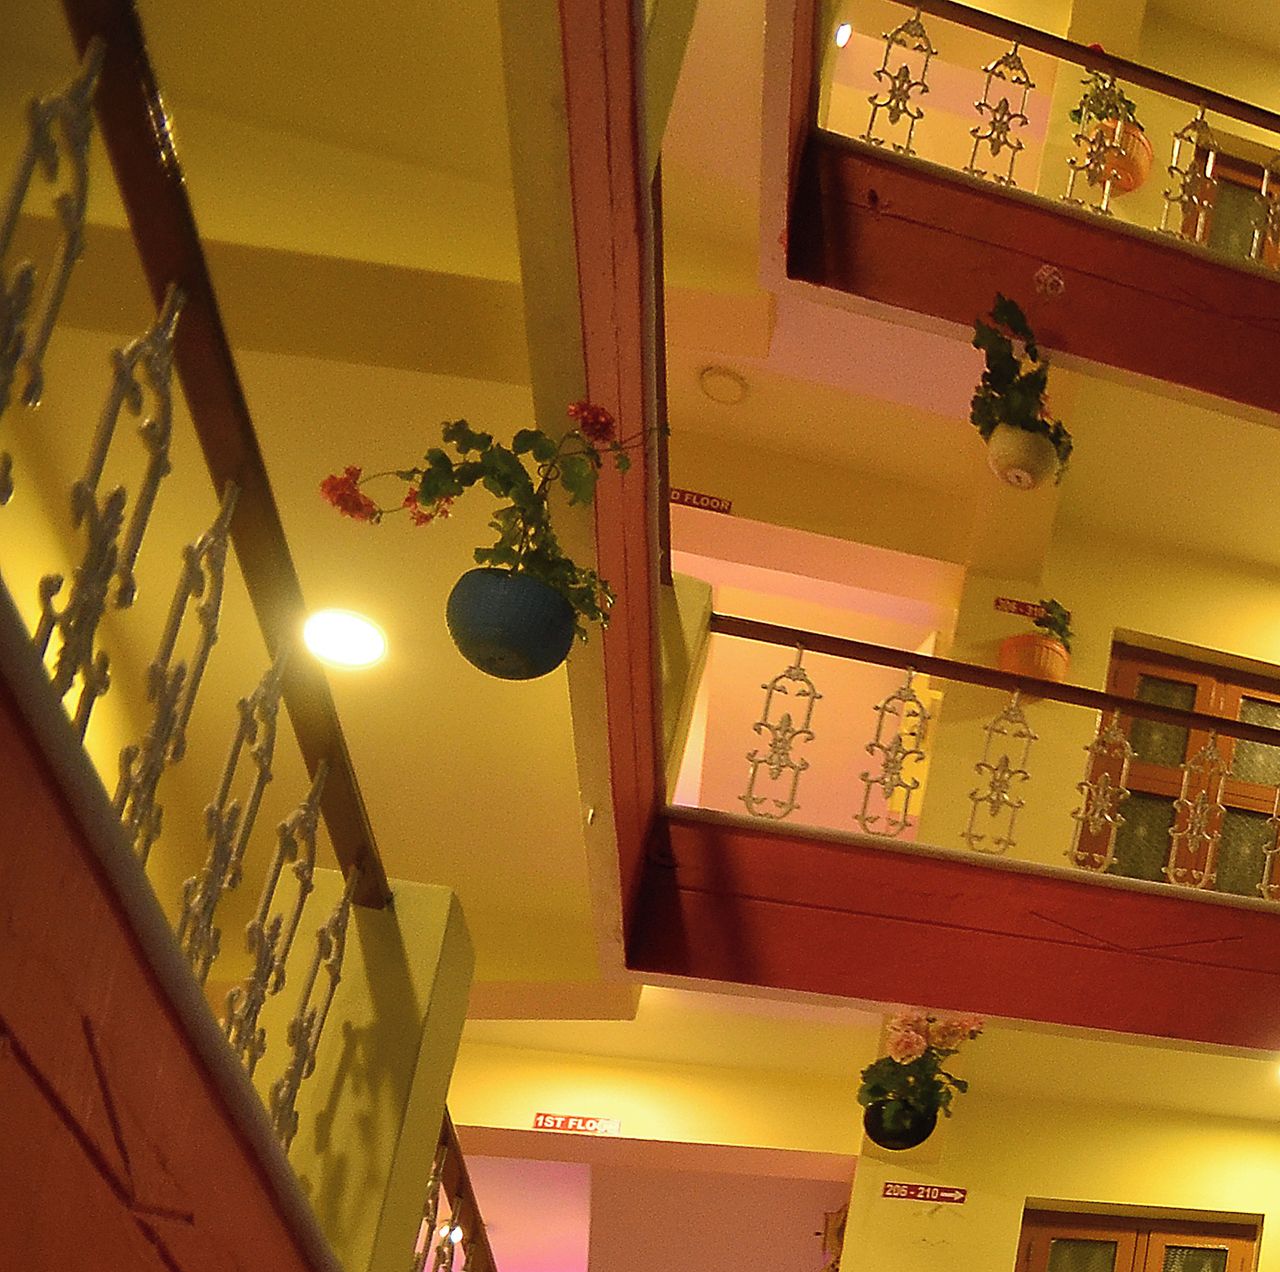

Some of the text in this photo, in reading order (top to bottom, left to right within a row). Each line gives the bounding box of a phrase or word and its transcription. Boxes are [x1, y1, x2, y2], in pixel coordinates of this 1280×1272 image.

[684, 493, 730, 510] FLOOR
[536, 1115, 565, 1129] 1ST
[917, 1186, 939, 1199] 210
